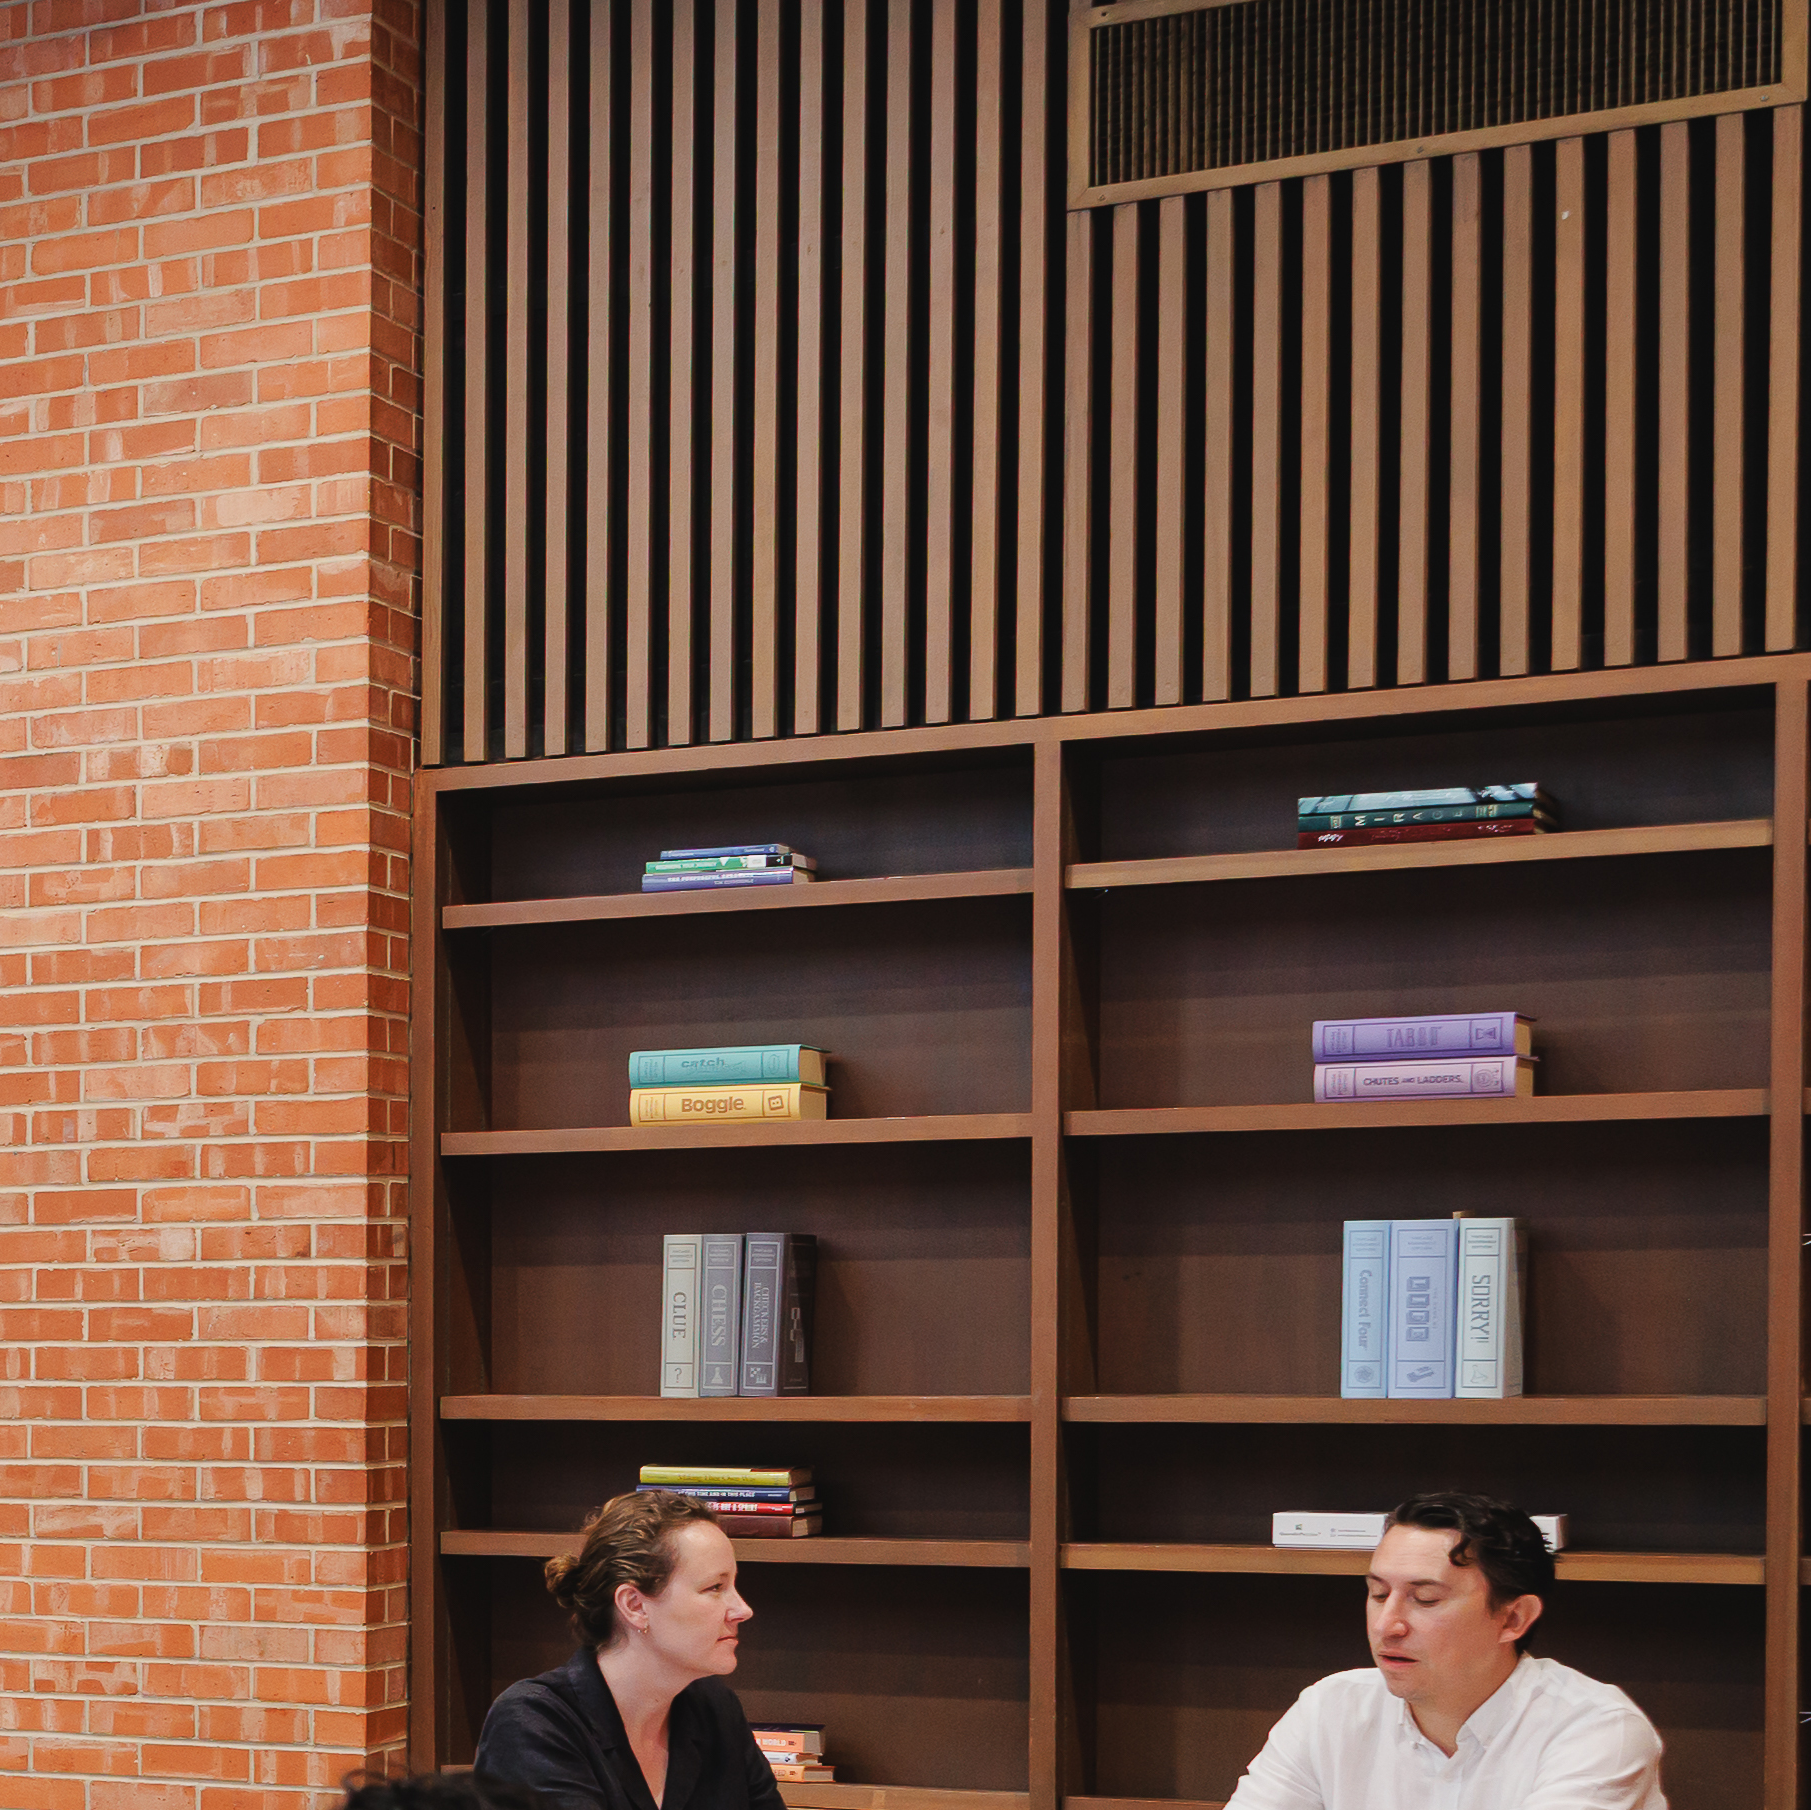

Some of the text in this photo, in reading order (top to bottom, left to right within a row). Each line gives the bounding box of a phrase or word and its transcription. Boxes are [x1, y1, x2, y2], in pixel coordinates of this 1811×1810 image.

[681, 1096, 744, 1114] Boggle
[1363, 1076, 1399, 1086] CHUTES
[1417, 1075, 1460, 1084] LADDERS
[672, 1291, 687, 1339] CLUE
[711, 1284, 727, 1346] CHESS
[752, 1282, 762, 1348] BACKGAMMON
[760, 1287, 770, 1336] CHECKERS
[1358, 1269, 1372, 1348] Connect Four
